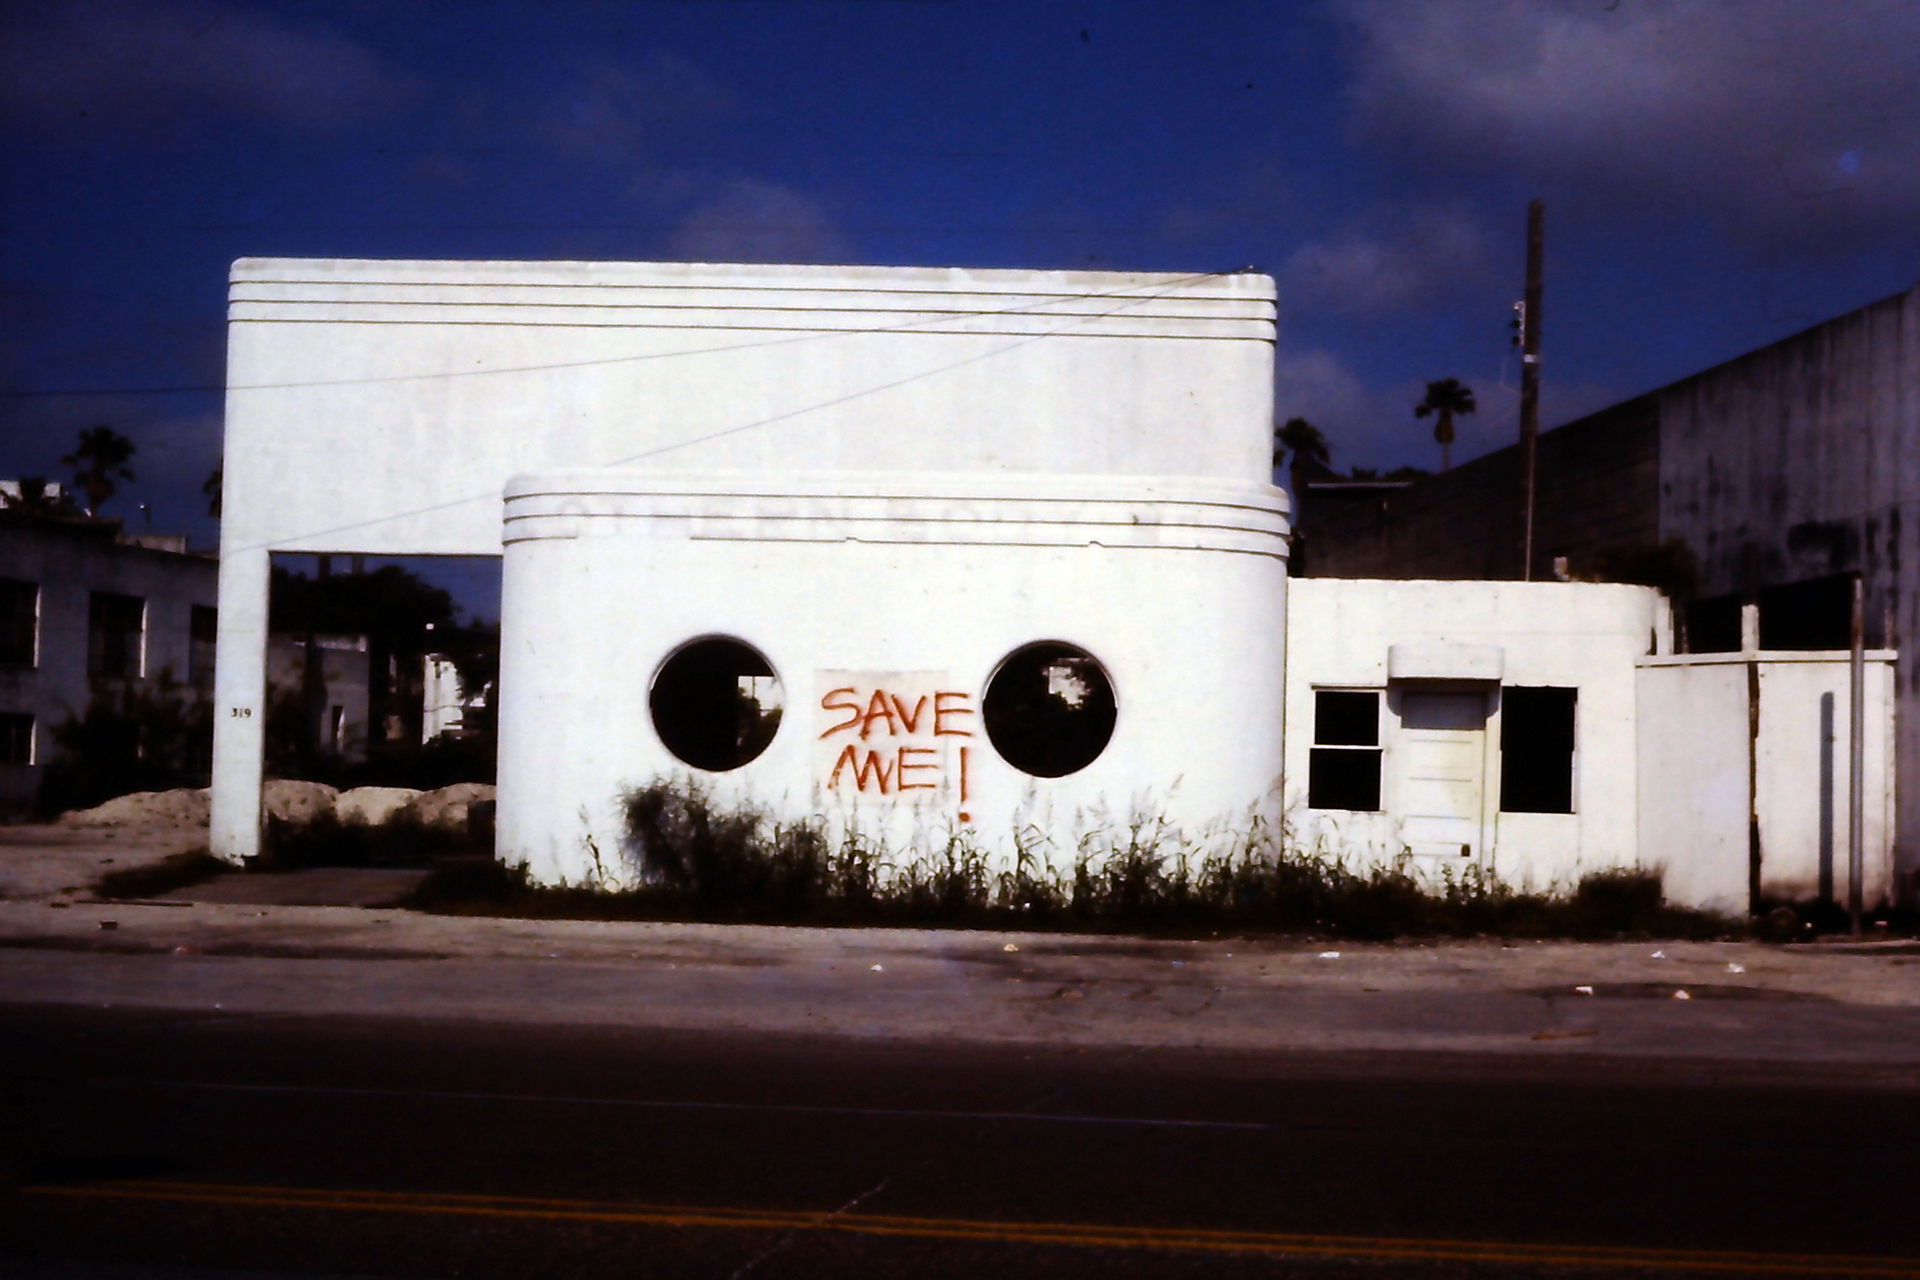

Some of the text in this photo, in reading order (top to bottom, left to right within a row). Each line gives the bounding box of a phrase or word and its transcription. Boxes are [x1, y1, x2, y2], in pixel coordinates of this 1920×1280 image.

[230, 707, 252, 718] 319
[819, 687, 975, 741] SAVE
[827, 744, 971, 823] ME!
